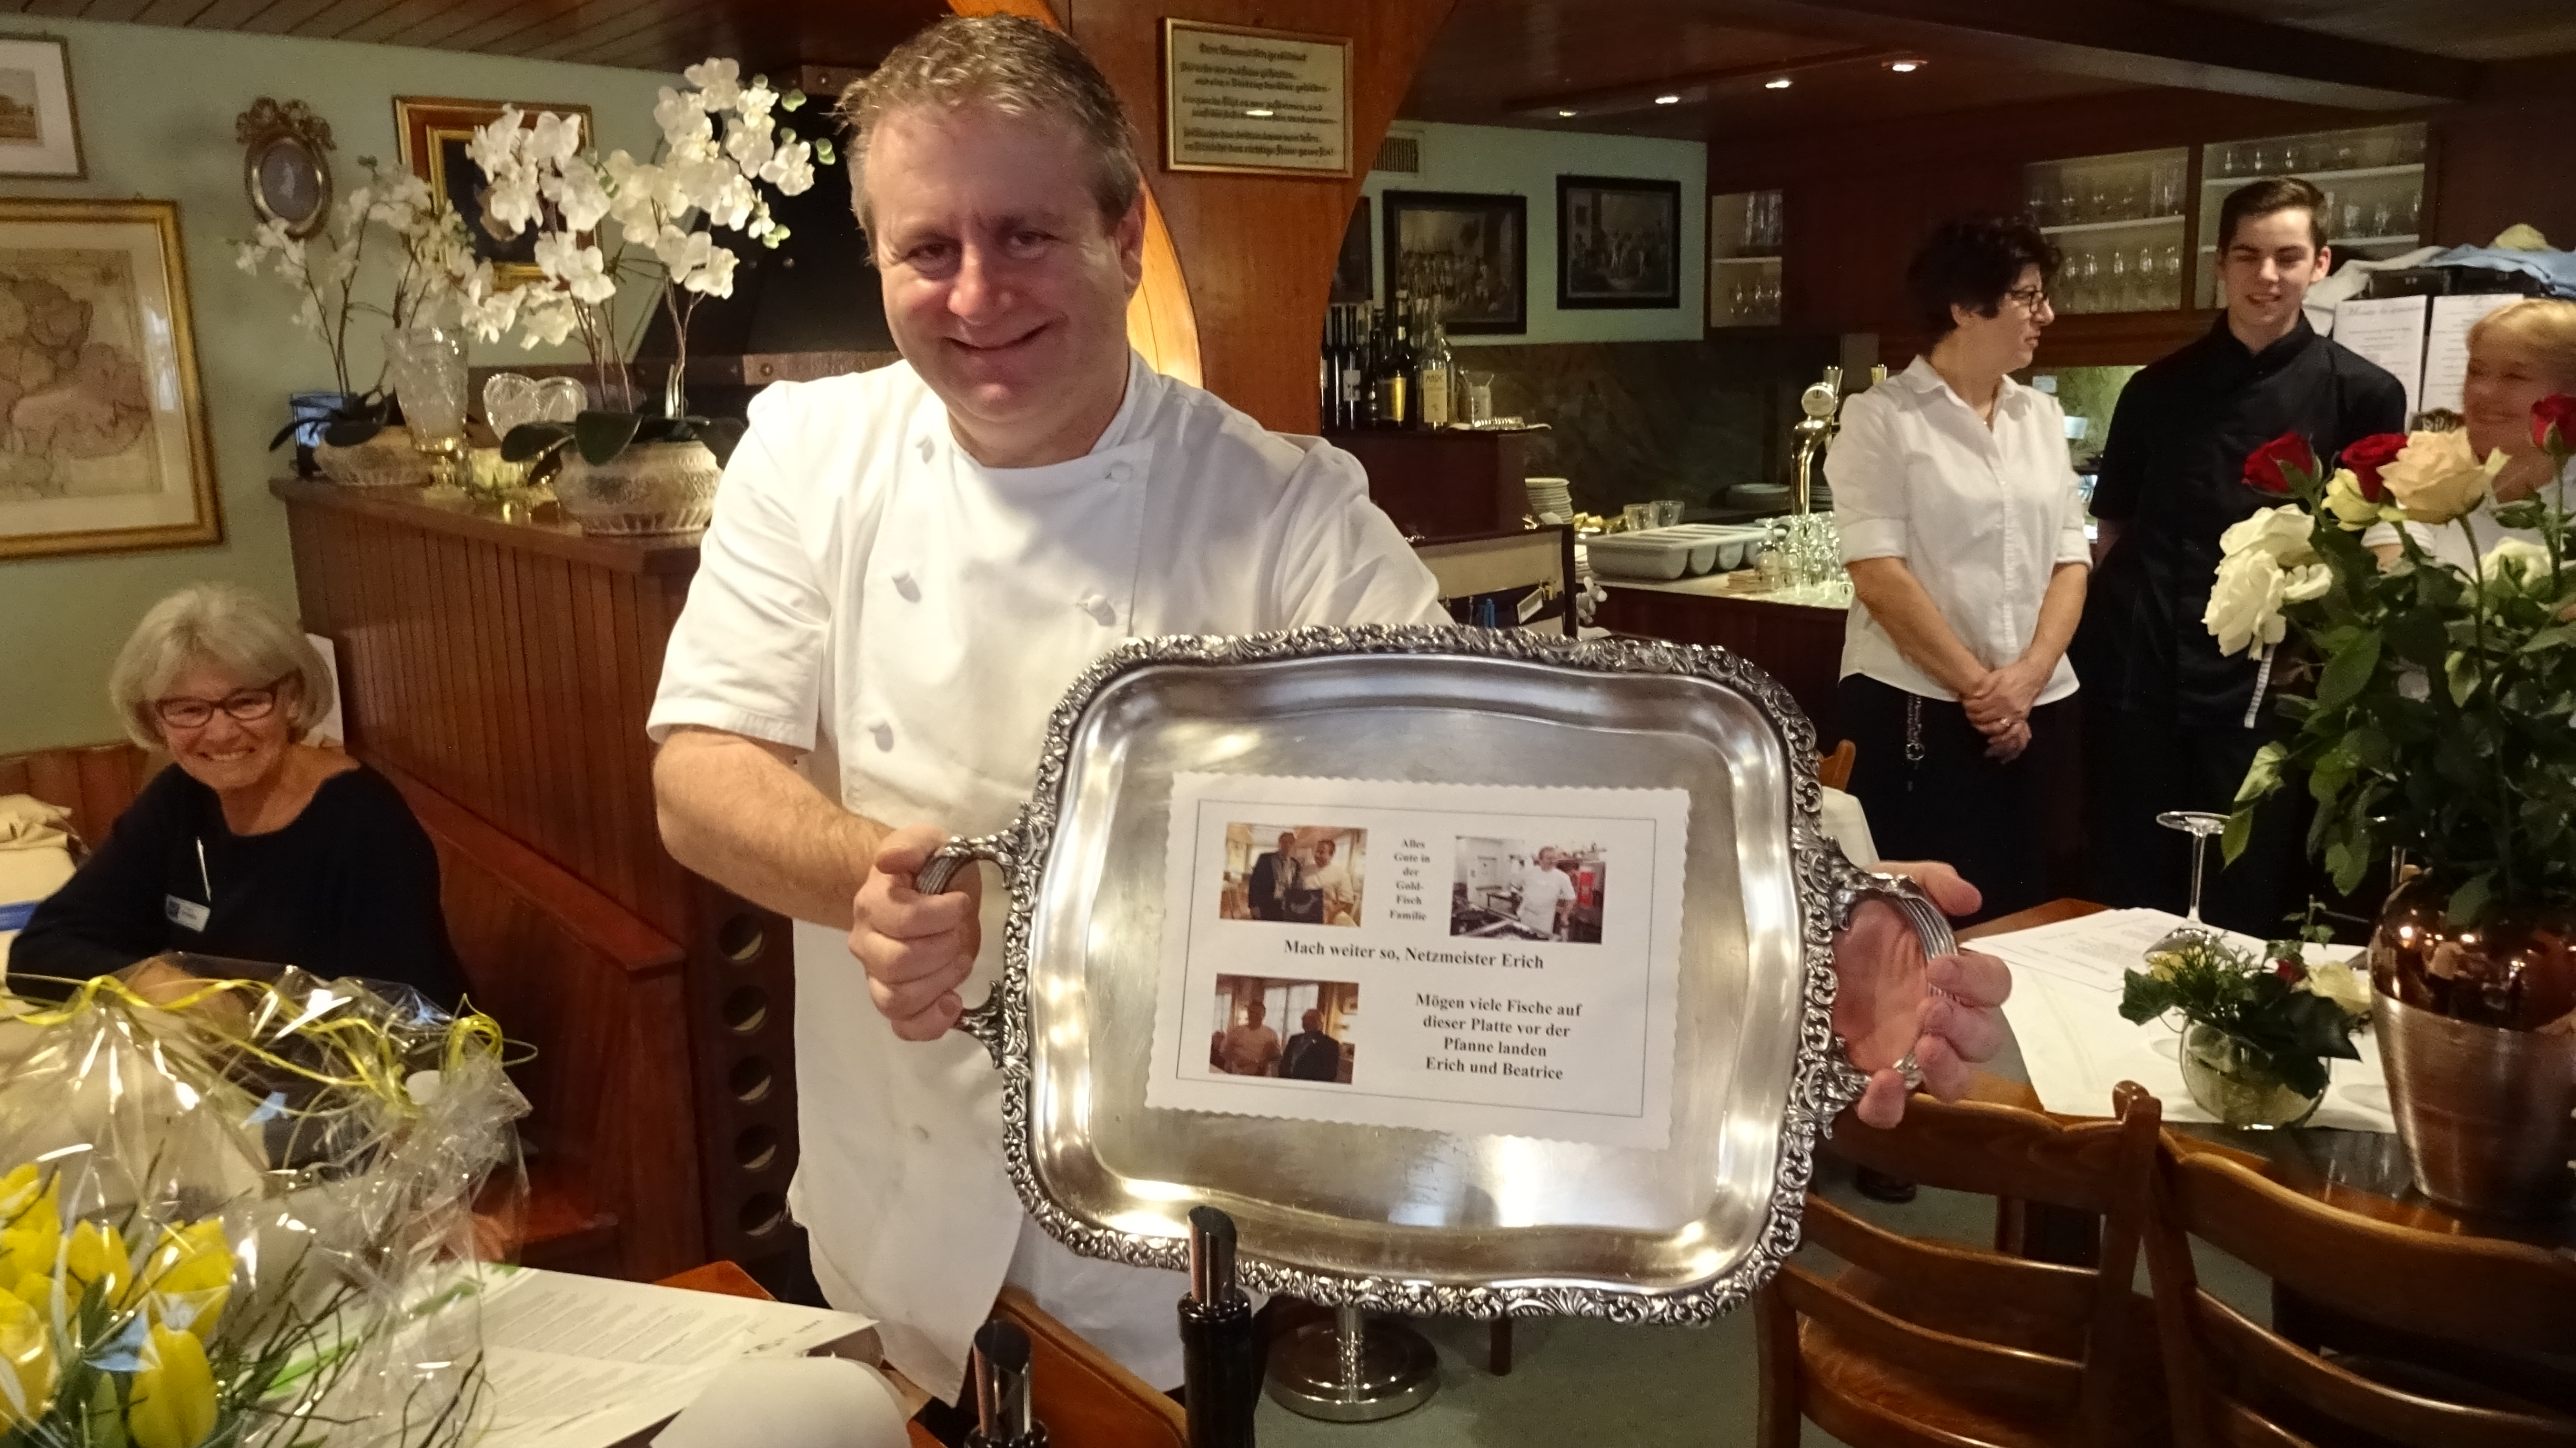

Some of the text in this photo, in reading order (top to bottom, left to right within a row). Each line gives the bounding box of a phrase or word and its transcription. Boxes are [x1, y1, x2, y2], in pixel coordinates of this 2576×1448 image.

[1402, 838, 1425, 849] Alles
[1393, 852, 1431, 863] Gute in
[1402, 866, 1419, 877] der
[1396, 894, 1422, 905] Fisch
[1390, 909, 1427, 921] Familie
[1284, 939, 1544, 969] Mach weiter so, Netzmeister Erich
[1415, 992, 1584, 1017] Mögen viele Fische auf
[1423, 1014, 1572, 1038] dieser Platte vor der
[1444, 1036, 1547, 1057] Pfanne landen
[1426, 1056, 1563, 1080] Erich und Beatrice
